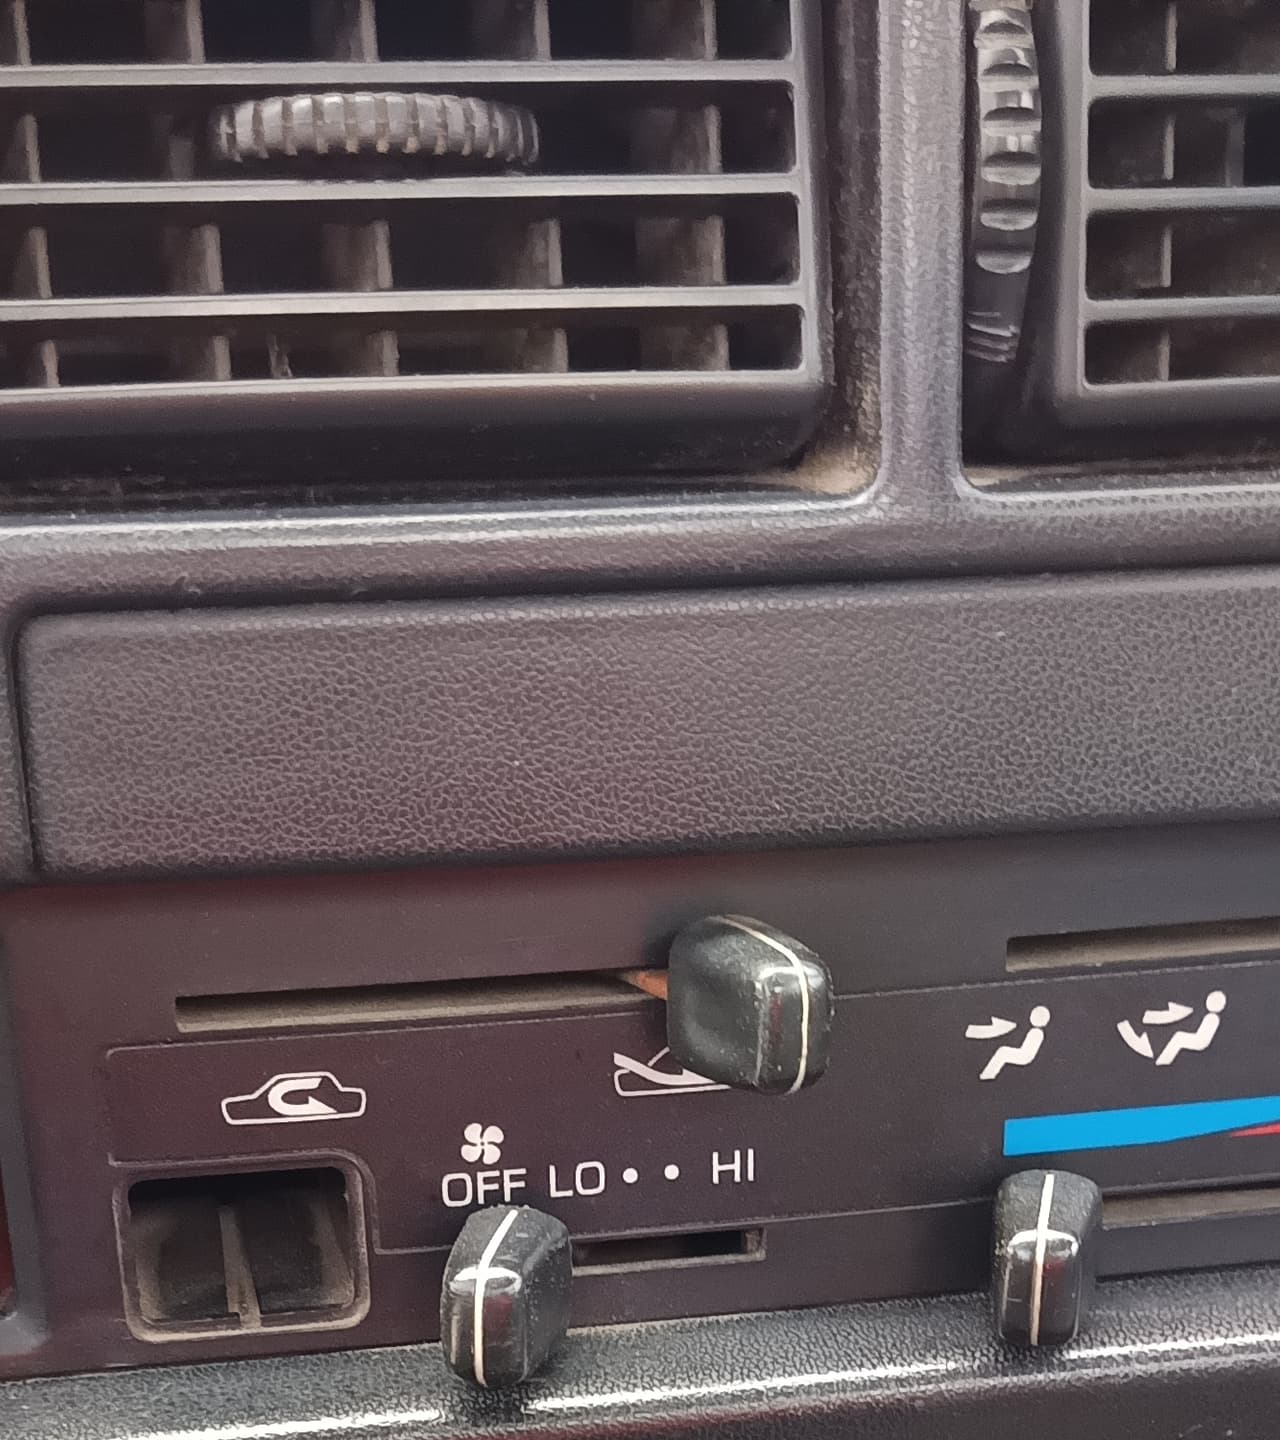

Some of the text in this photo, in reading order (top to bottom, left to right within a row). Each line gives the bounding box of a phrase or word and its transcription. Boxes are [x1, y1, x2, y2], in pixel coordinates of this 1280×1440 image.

[441, 1148, 754, 1208] OFF LO HI
